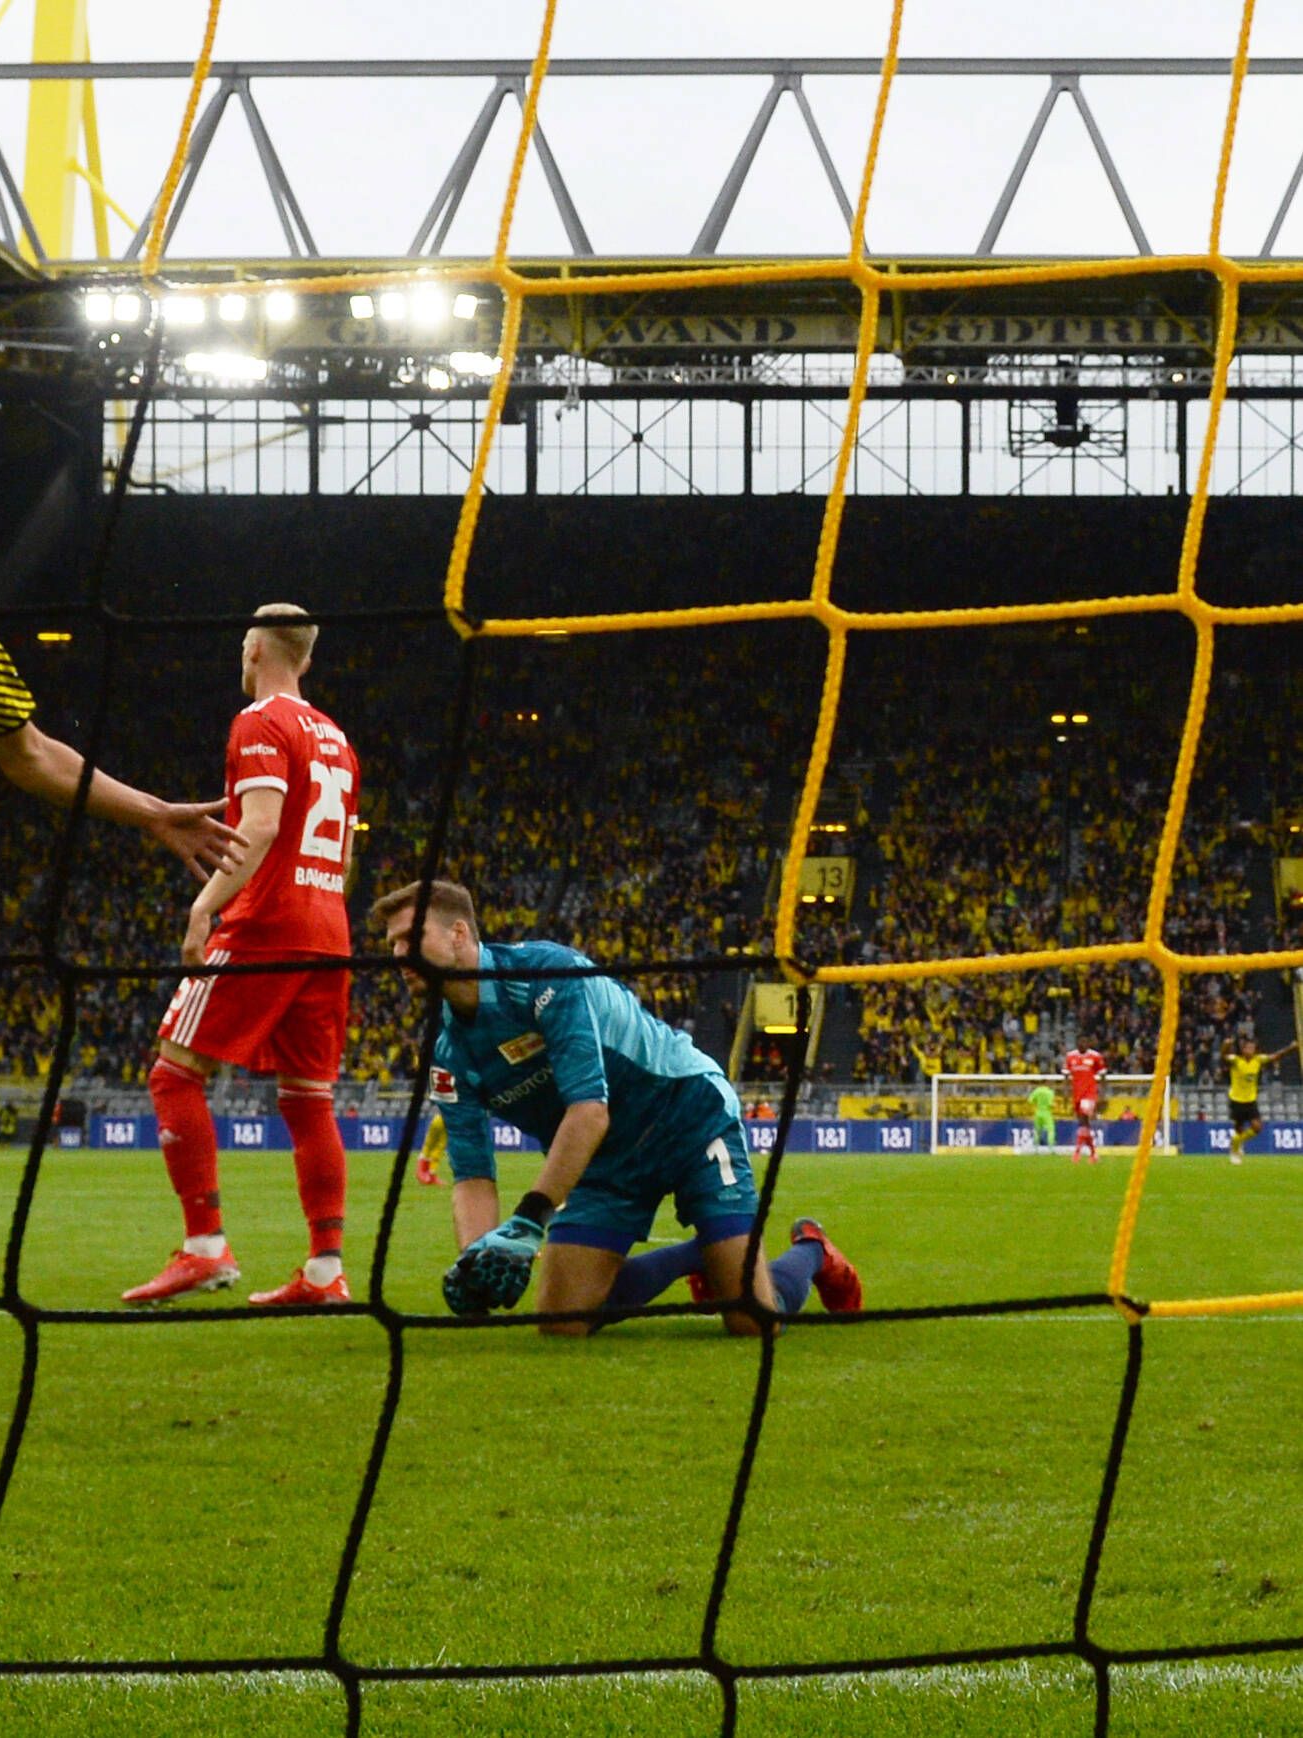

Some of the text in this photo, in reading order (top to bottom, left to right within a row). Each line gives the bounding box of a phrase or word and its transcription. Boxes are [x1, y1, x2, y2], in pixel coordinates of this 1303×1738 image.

[598, 317, 797, 344] WAND
[299, 759, 353, 863] 25
[817, 866, 843, 889] 13
[105, 1122, 135, 1144] 1&1
[233, 1123, 263, 1145] 1&1
[362, 1124, 390, 1145] 1&1
[493, 1125, 522, 1146] 1&1
[816, 1126, 847, 1148] 1&1
[881, 1126, 912, 1148] 1&1
[947, 1127, 977, 1147] 1&1
[1273, 1128, 1303, 1149] 1&1
[705, 1136, 738, 1187] 1
